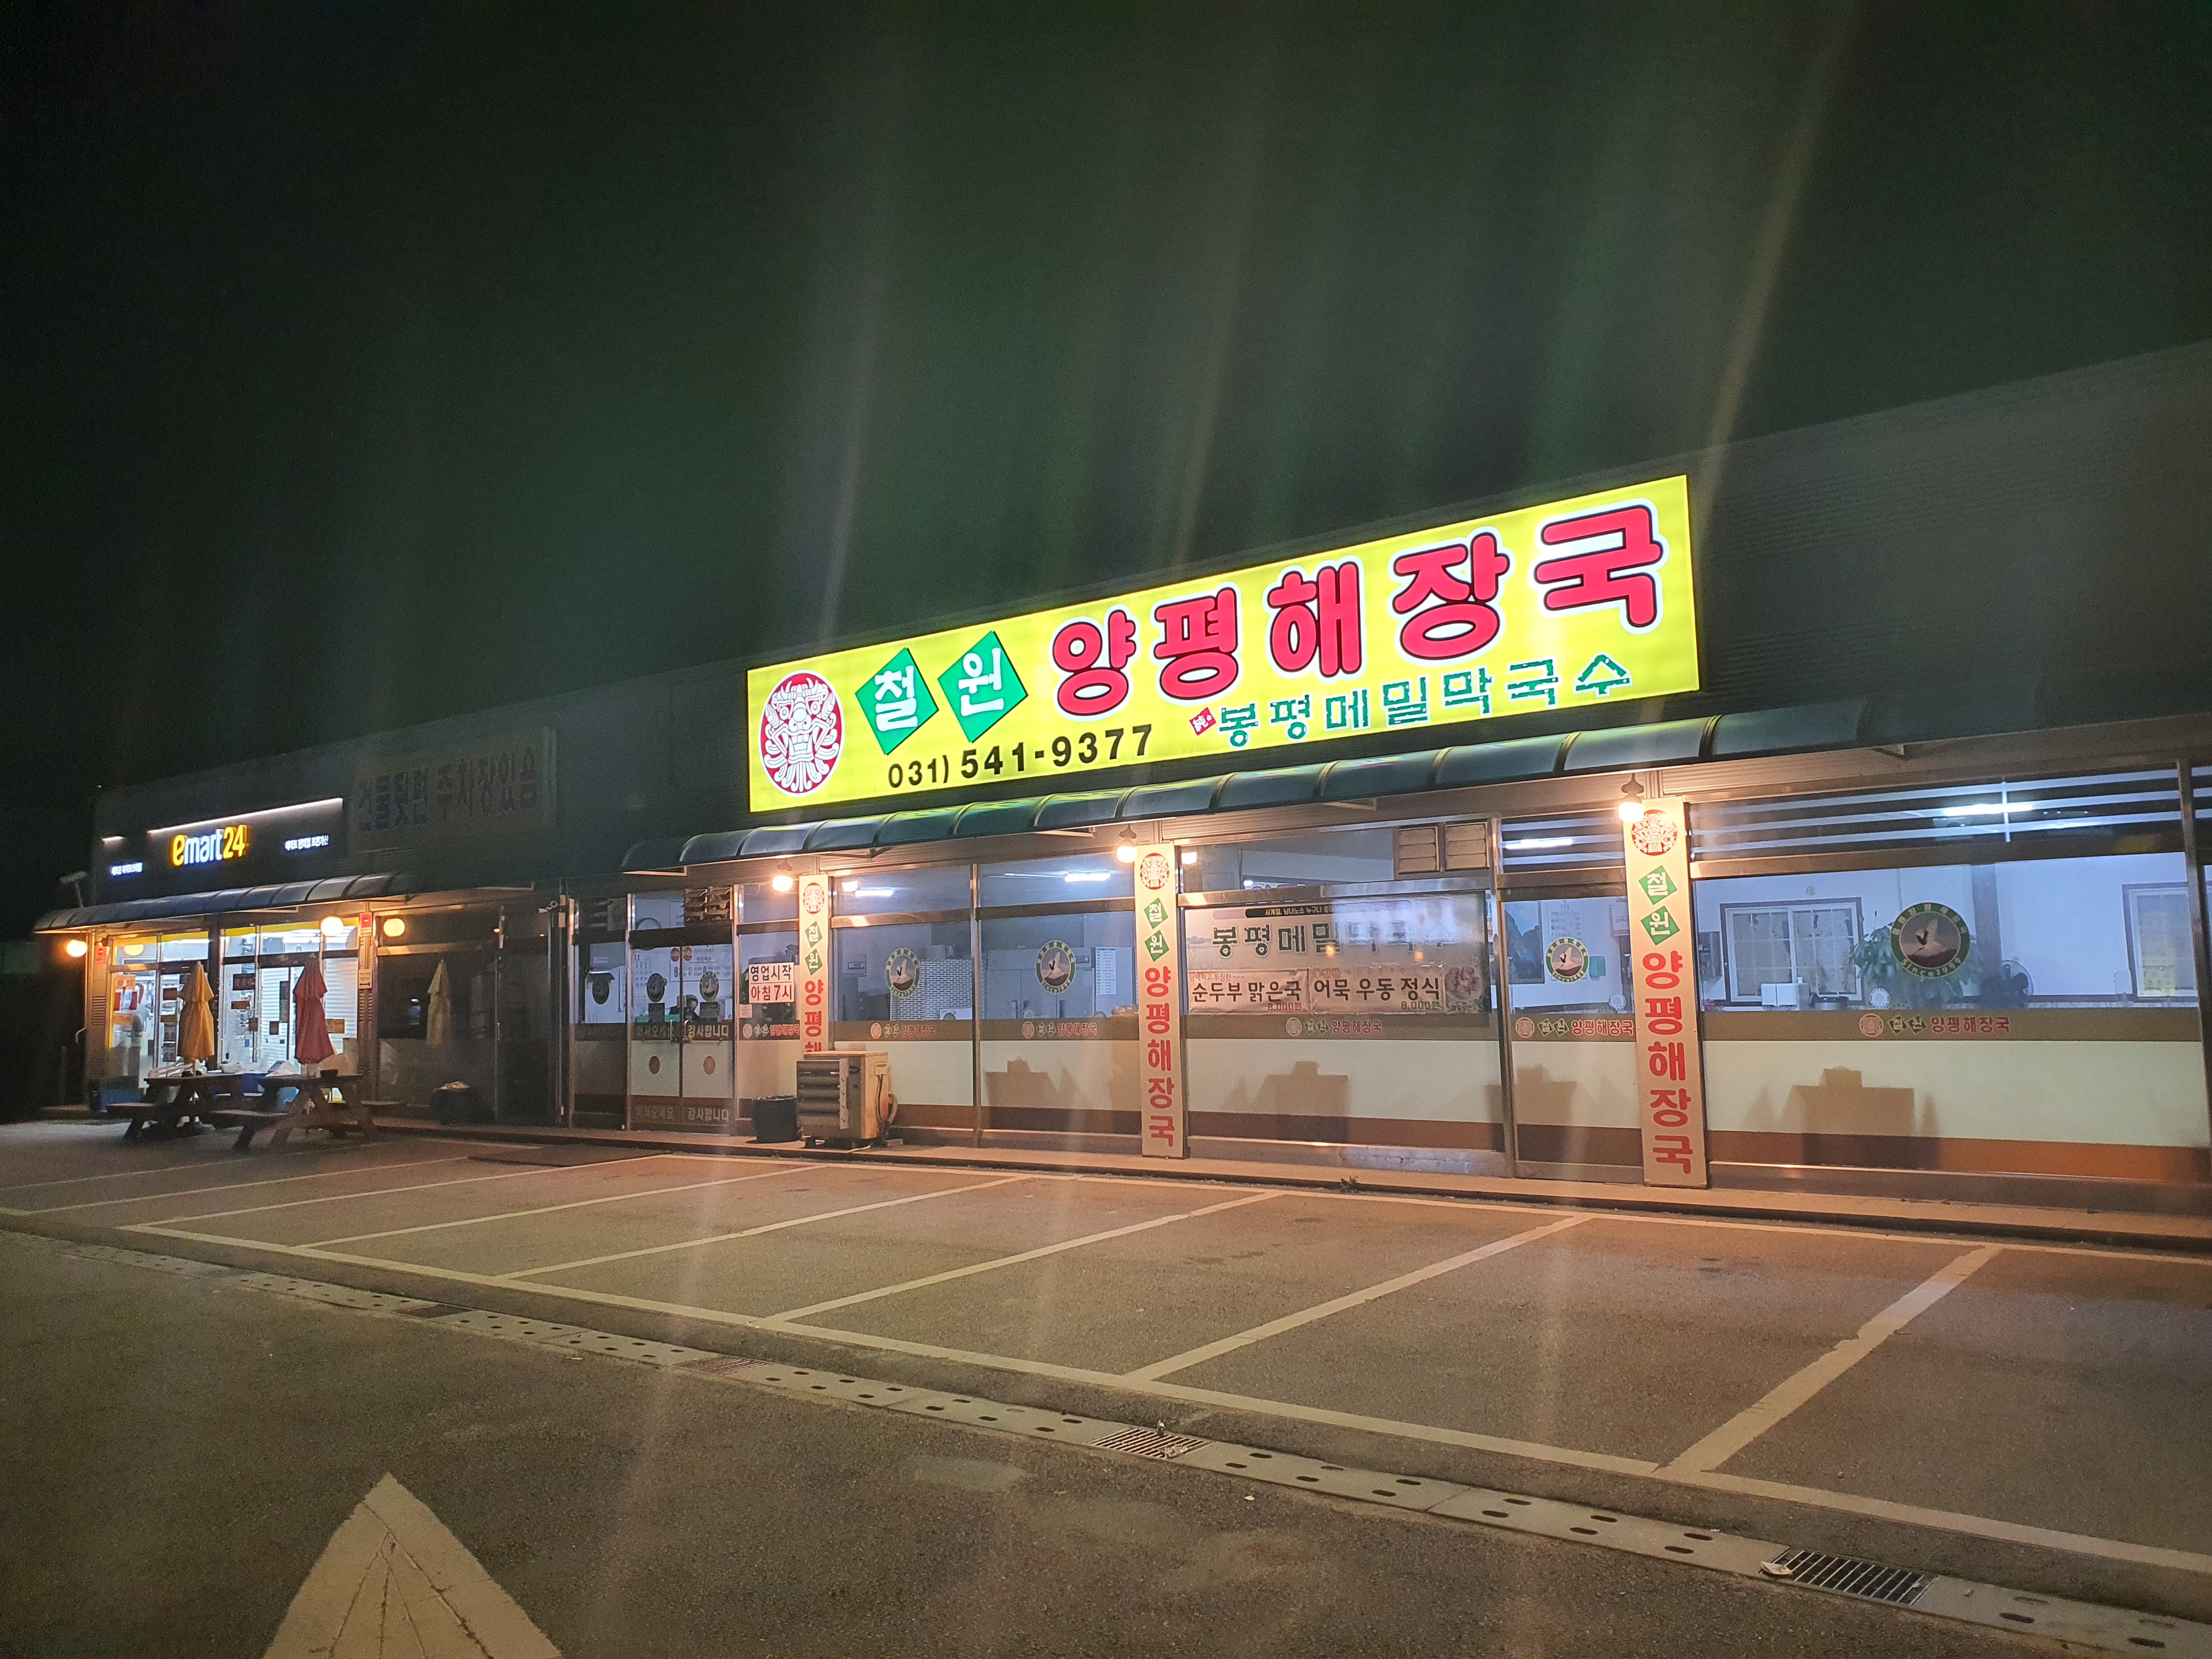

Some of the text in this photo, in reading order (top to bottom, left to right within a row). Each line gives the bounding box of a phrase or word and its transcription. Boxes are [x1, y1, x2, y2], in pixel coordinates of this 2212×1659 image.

[874, 504, 1663, 732] 철원 양평해장국
[1219, 654, 1630, 747] 봉평메밀막국수
[172, 824, 247, 866] emart24
[1306, 906, 1322, 915] 누구나
[750, 964, 792, 982] 영업시작
[1214, 973, 1231, 981] 푸짐한
[751, 984, 792, 1001] 아침 7시
[1192, 980, 1302, 1002] 순두부 맑은국
[1314, 977, 1440, 1001] 어묵 우동 정식
[687, 1024, 729, 1037] 감사합니다
[1057, 1022, 1097, 1036] 양평해장국
[1145, 901, 1175, 1147] 철원 양평해장국
[1331, 1019, 1383, 1034] 양평해장국
[1571, 1019, 1634, 1036] 양평해장국
[1641, 871, 1694, 1175] 철원 양평해장국
[1931, 1015, 2010, 1033] 양평해장국
[687, 1107, 729, 1122] 감사합니다
